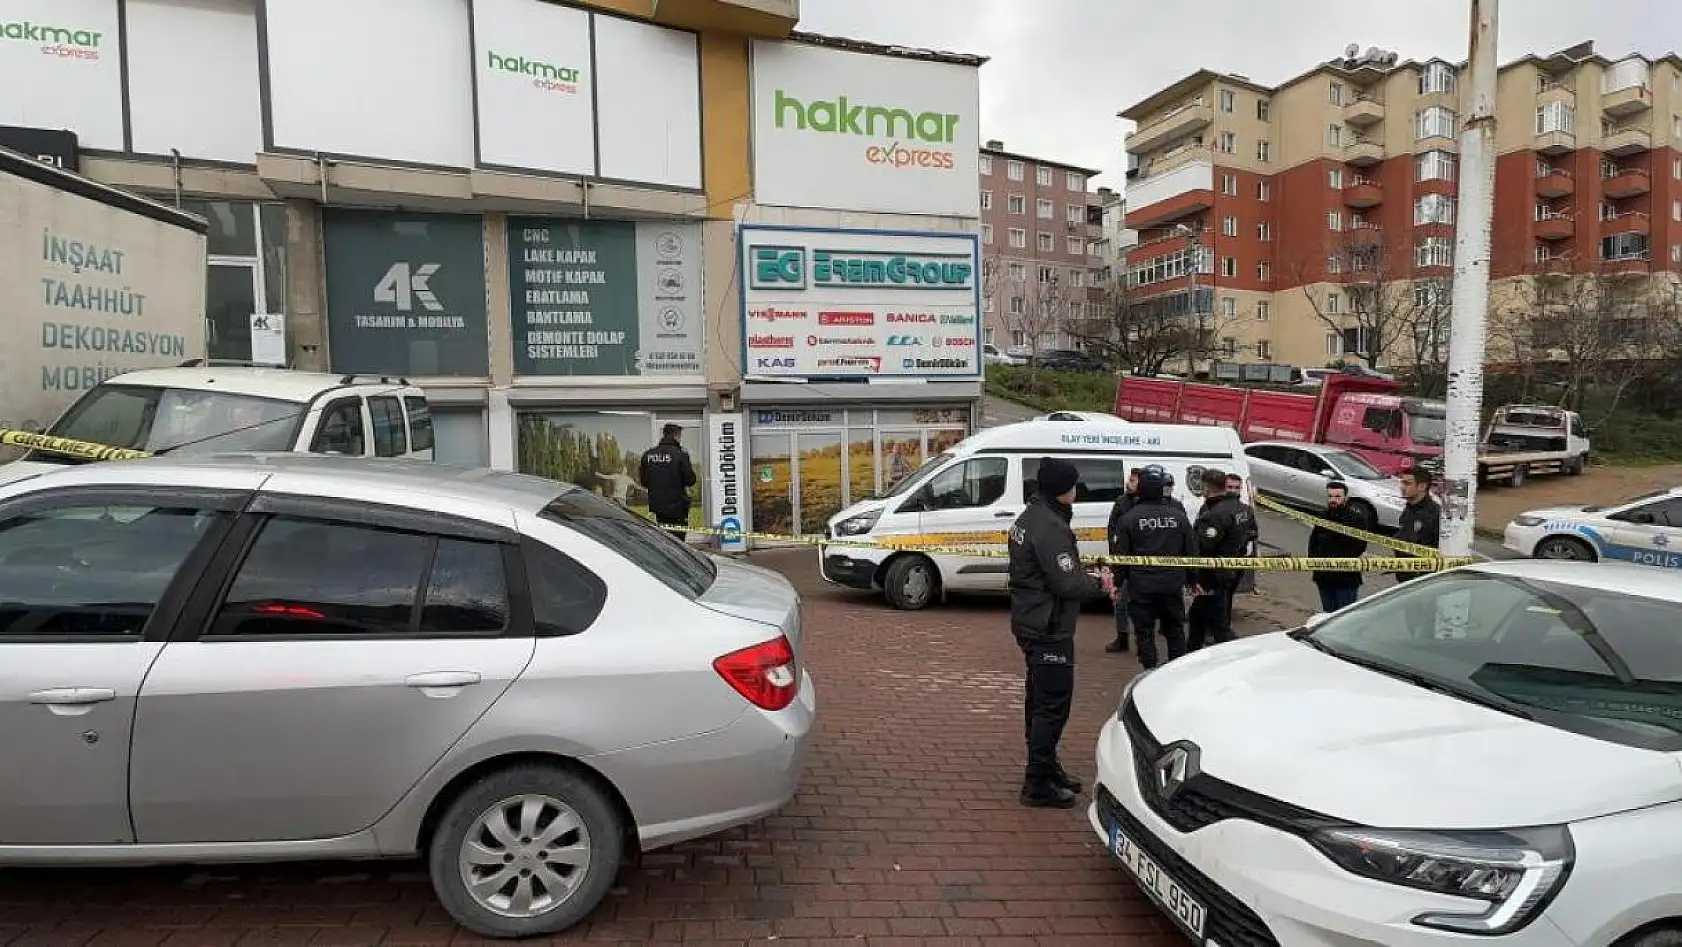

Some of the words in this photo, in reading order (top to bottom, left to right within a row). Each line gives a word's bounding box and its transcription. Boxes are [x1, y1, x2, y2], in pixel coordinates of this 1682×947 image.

[488, 50, 580, 83] hakmar
[774, 89, 960, 142] hakmar
[866, 142, 954, 169] express
[523, 228, 550, 244] CNC
[43, 227, 124, 274] İNŞAAT
[524, 249, 554, 262] LAKE
[556, 250, 597, 263] KAPAK
[374, 262, 444, 311] 4K
[565, 270, 606, 284] KAPAK
[42, 278, 146, 316] TAAHHÜT
[355, 315, 405, 328] TASARIM
[527, 311, 592, 324] BANTLAMA
[42, 322, 185, 357] DEKORASYON
[527, 331, 585, 345] DEMONTE
[586, 331, 626, 345] DOLAP
[945, 337, 975, 346] BOSCH
[719, 421, 737, 515] DemirDöküm
[1370, 560, 1405, 570] KAZA
[1114, 832, 1132, 864] 34
[1137, 852, 1164, 897] FSL
[1169, 883, 1202, 932] 950
